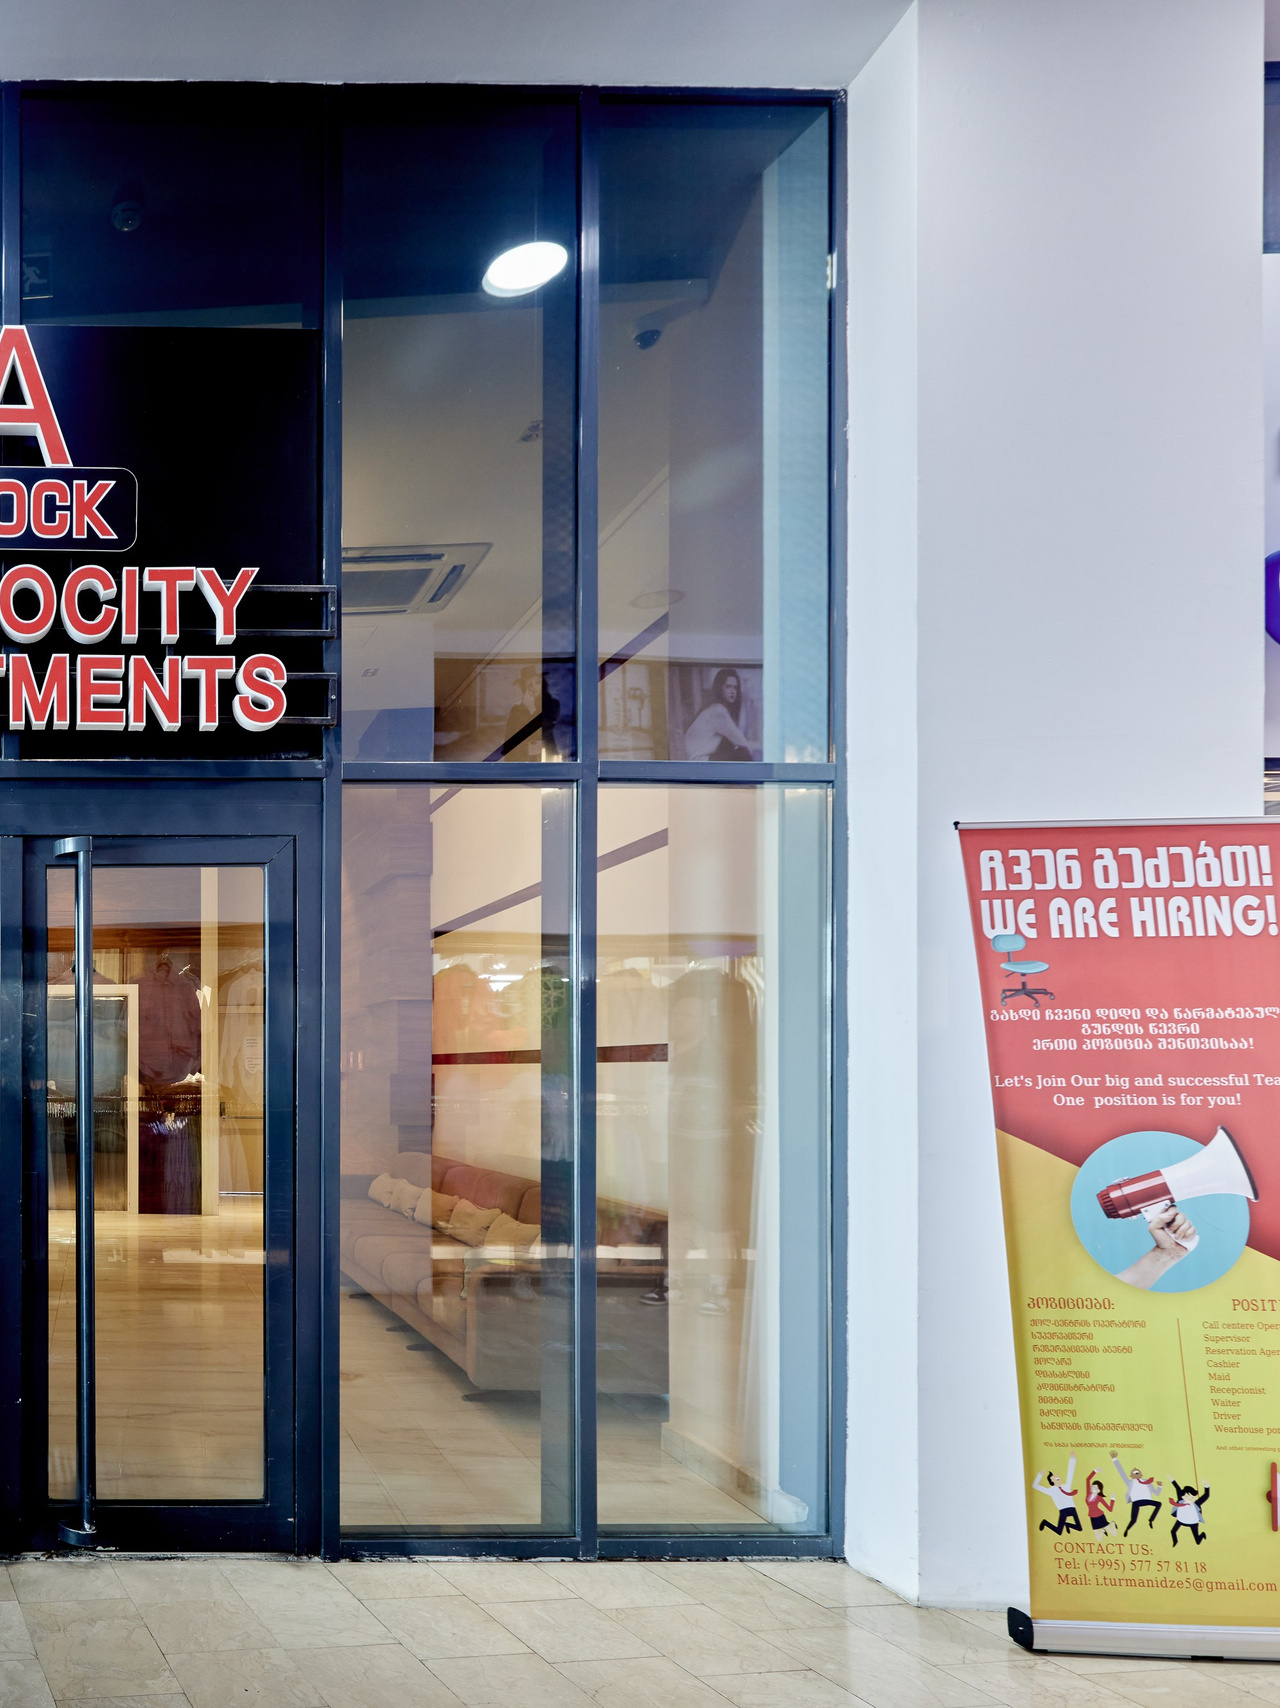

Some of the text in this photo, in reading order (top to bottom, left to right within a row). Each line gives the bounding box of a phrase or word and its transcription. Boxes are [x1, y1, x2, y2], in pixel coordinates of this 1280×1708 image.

[979, 848, 1082, 891] ჩვენ
[980, 894, 1279, 940] WE ARE HIRING!
[990, 1009, 1041, 1021] გახდი
[1045, 1008, 1092, 1021] ჩვენი
[1095, 1008, 1142, 1020] დიდი
[1145, 1008, 1169, 1020] და
[1081, 1023, 1144, 1036] გუნდის
[1032, 1037, 1254, 1051] ერთი პოზიცია შენთვისაა!
[994, 1075, 1033, 1087] Let's
[1035, 1074, 1067, 1089] Join
[1071, 1074, 1102, 1087] Our
[1105, 1074, 1130, 1089] big
[1134, 1073, 1164, 1086] and
[1168, 1073, 1250, 1086] successful
[1053, 1093, 1242, 1109] One position is for you!
[1027, 1297, 1115, 1310] პოზიციები:
[1232, 1298, 1280, 1311] POSIT
[1202, 1321, 1219, 1329] Call
[1222, 1321, 1255, 1329] centere
[1204, 1334, 1251, 1343] Supervisor
[1205, 1346, 1257, 1355] Reservation
[1207, 1359, 1241, 1368] Cashier
[1208, 1372, 1231, 1381] Maid
[1210, 1385, 1267, 1395] Recepcionist
[1211, 1398, 1242, 1407] Waiter
[1213, 1411, 1242, 1420] Driver
[1214, 1424, 1264, 1433] Wearhouse
[1053, 1541, 1154, 1555] CONTACT US:
[1054, 1557, 1207, 1573] Tel: (+995) 577 57 81 18
[1057, 1573, 1278, 1593] Mail: i.turmanidze5@gmail.com
